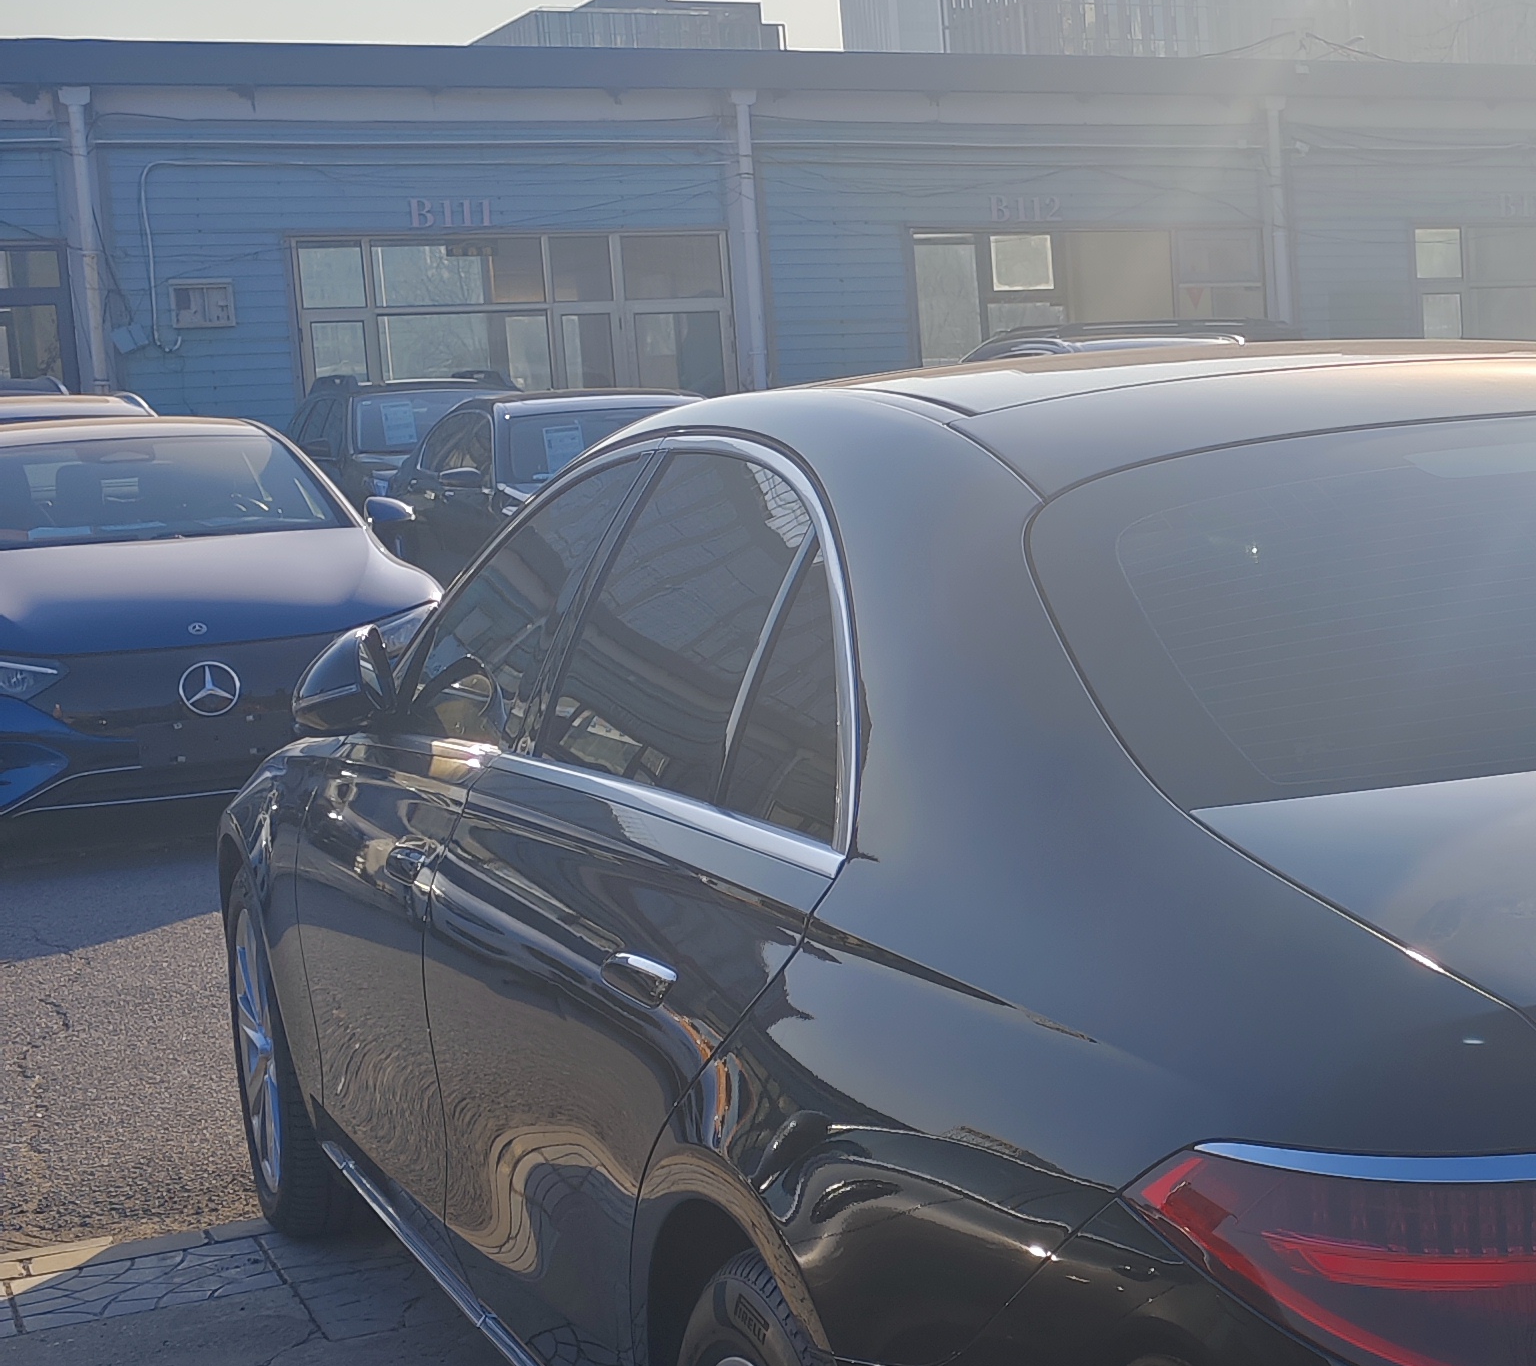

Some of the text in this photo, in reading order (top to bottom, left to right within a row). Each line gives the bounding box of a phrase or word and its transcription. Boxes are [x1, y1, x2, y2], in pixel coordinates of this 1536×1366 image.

[408, 197, 494, 229] B111
[988, 195, 1063, 223] B112
[733, 1292, 770, 1346] PIRELLI
